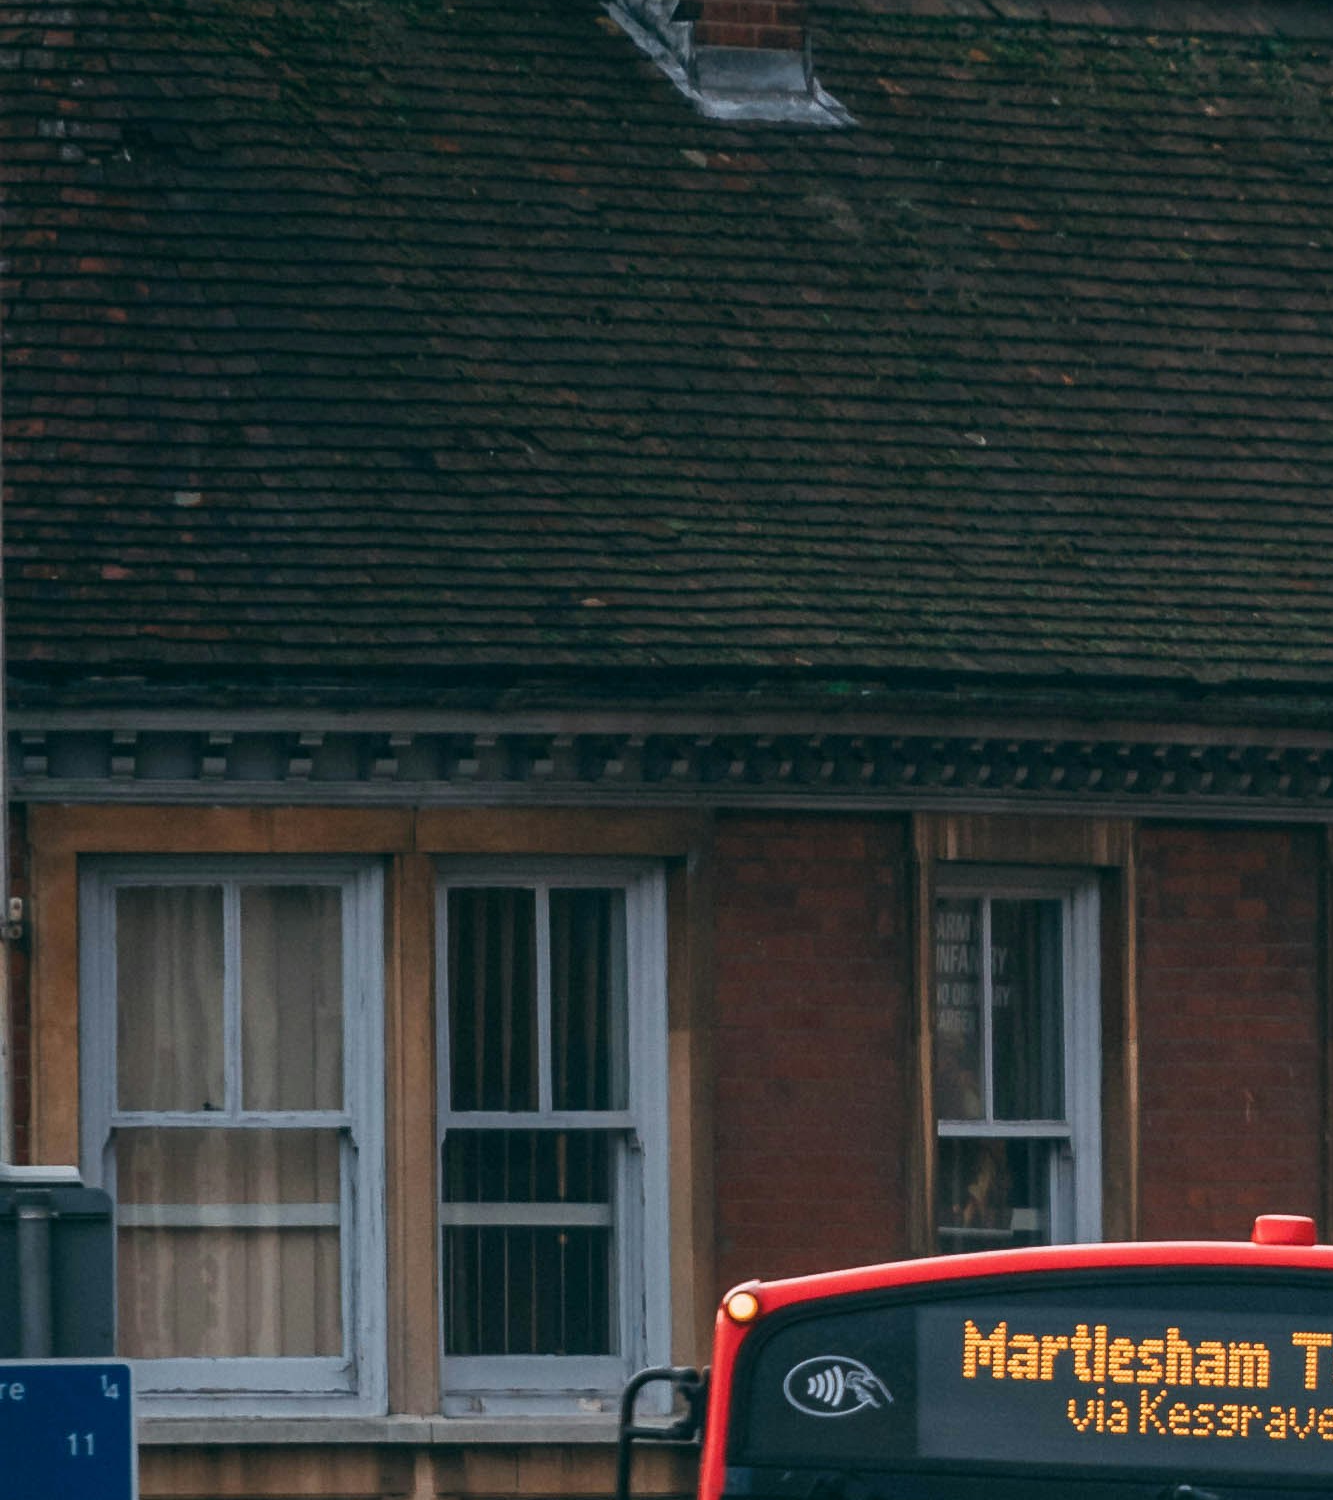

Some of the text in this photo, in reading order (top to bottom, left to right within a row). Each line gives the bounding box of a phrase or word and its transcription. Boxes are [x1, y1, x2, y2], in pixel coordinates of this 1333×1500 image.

[963, 1319, 1270, 1389] Martlesham
[1066, 1386, 1129, 1433] via
[67, 1433, 94, 1456] 11
